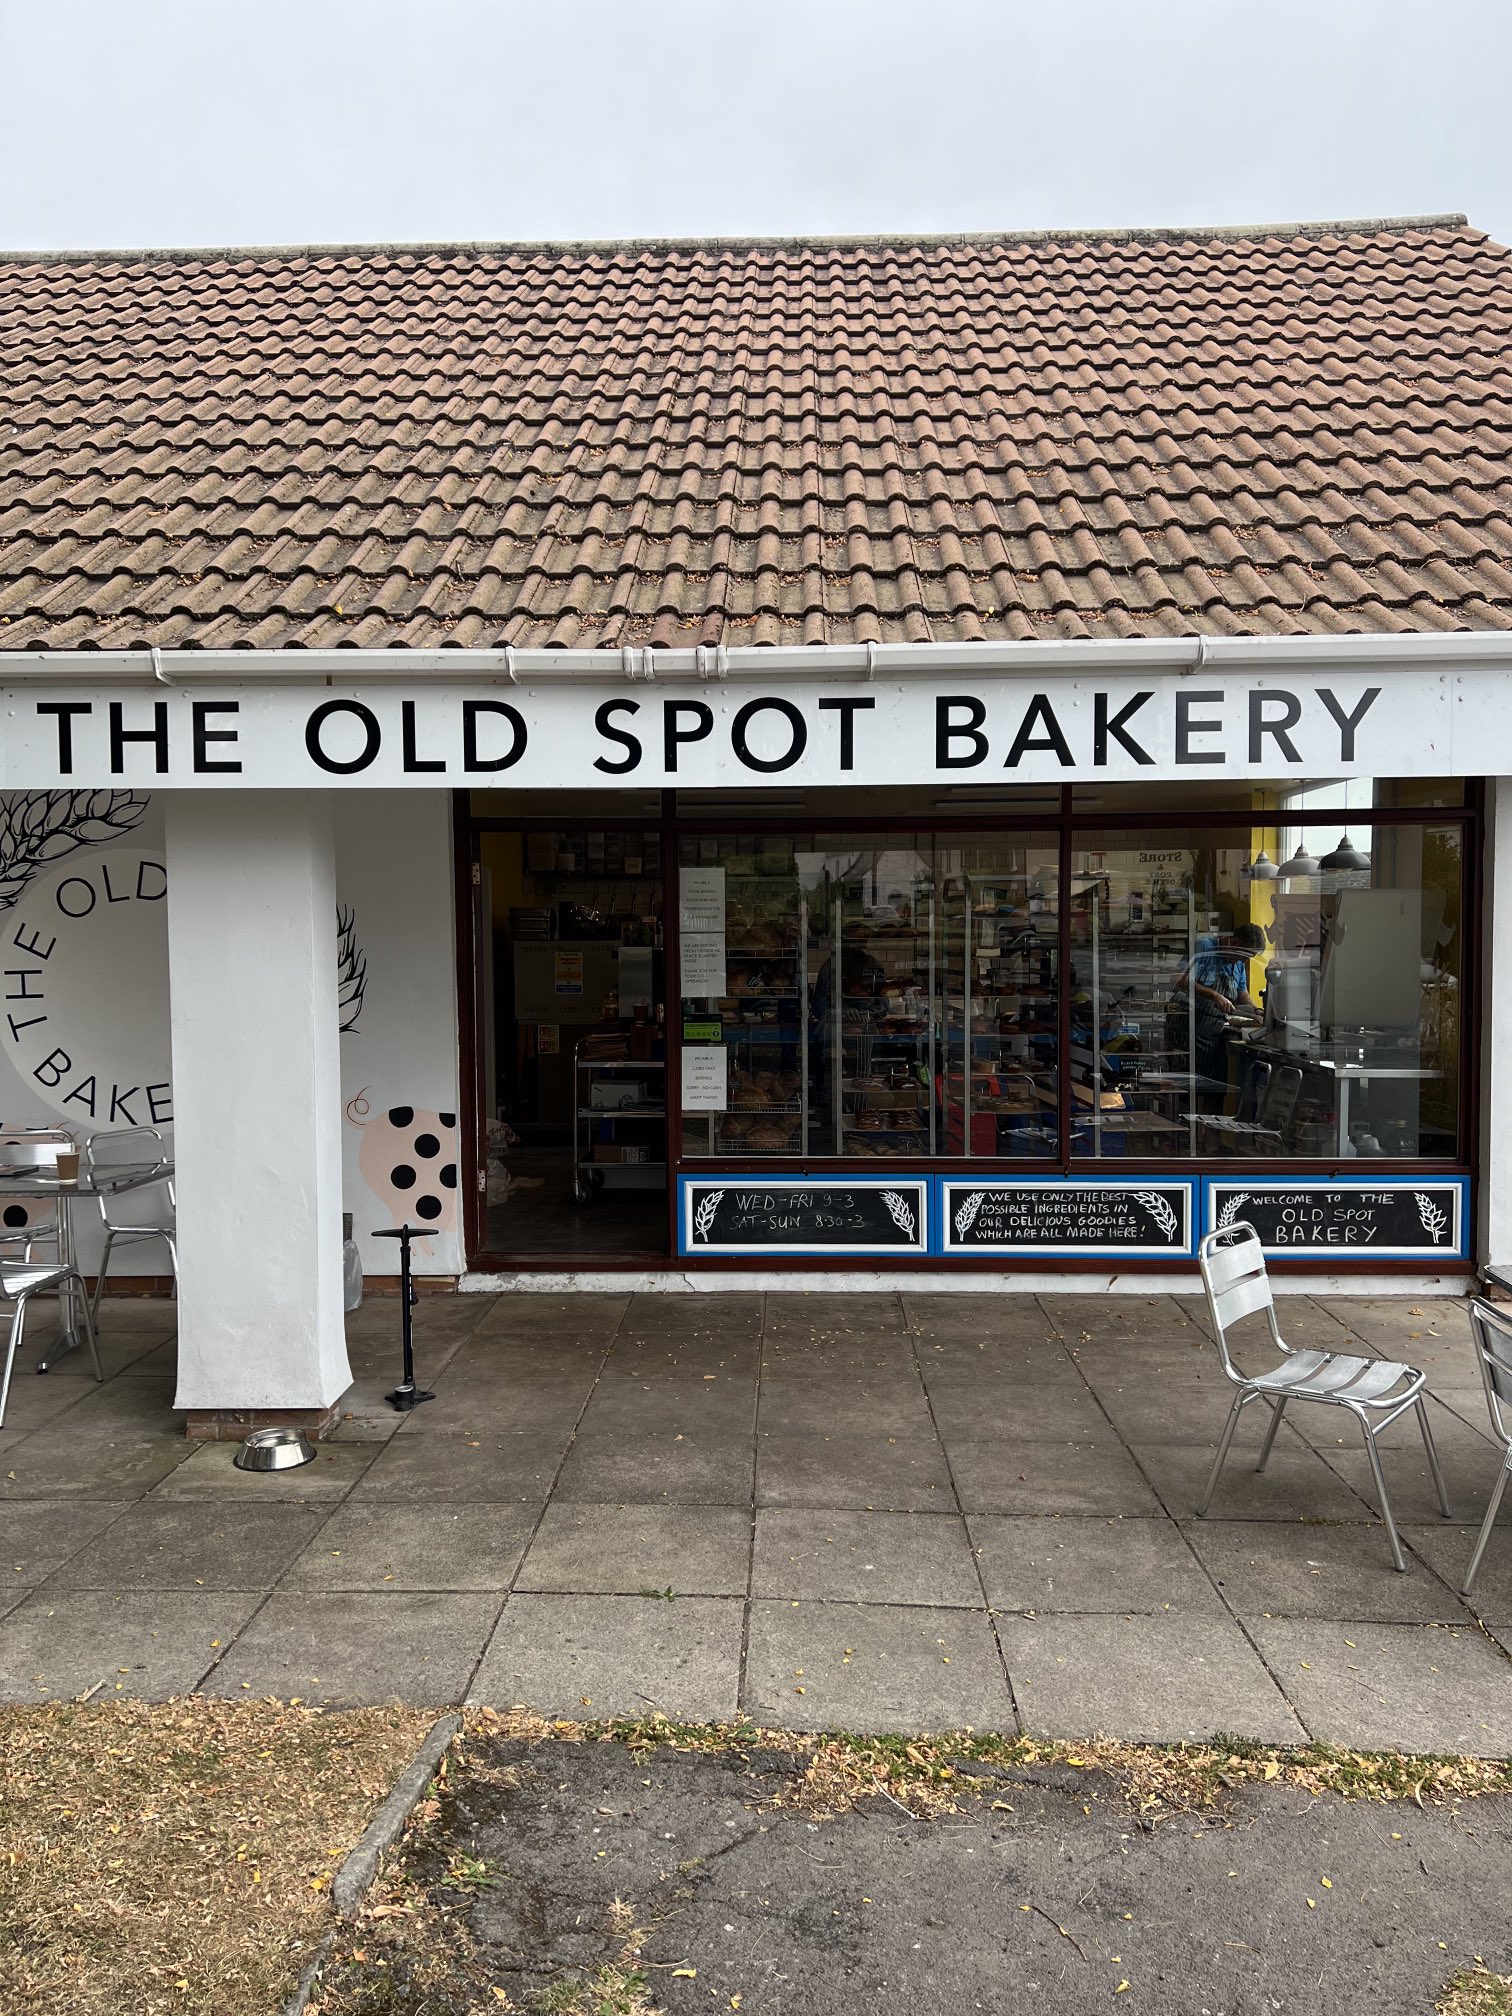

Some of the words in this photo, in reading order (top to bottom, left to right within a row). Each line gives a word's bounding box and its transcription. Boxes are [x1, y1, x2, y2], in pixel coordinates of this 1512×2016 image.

[36, 701, 243, 774] THE
[305, 698, 529, 775] OLD
[592, 696, 876, 775] SPOT
[935, 687, 1383, 769] BAKERY
[4, 922, 57, 1043] THE
[56, 860, 168, 918] OLD
[823, 1193, 855, 1208] 9-3
[989, 1191, 1012, 1202] WE
[1017, 1191, 1039, 1202] USE
[1042, 1191, 1075, 1203] ONLY
[1075, 1191, 1099, 1202] THE
[1101, 1191, 1128, 1202] BEST
[1252, 1194, 1314, 1206] WELCOME
[1325, 1194, 1341, 1203] TO
[1359, 1193, 1395, 1205] THE
[981, 1204, 1030, 1215] POSSIBLE
[1035, 1204, 1110, 1214] INGREDIENTS
[1114, 1204, 1129, 1214] IN
[1282, 1208, 1324, 1223] OLD
[1333, 1208, 1376, 1222] SPOT
[979, 1216, 1003, 1229] OUR
[1010, 1216, 1072, 1227] DELICIOUS
[1078, 1216, 1137, 1227] GOODIES
[975, 1229, 1012, 1240] WHICH
[1015, 1228, 1038, 1239] ARE
[1040, 1227, 1063, 1239] ALL
[1066, 1226, 1106, 1238] MADE
[1108, 1225, 1146, 1239] HERE!
[1275, 1225, 1378, 1244] BAKERY
